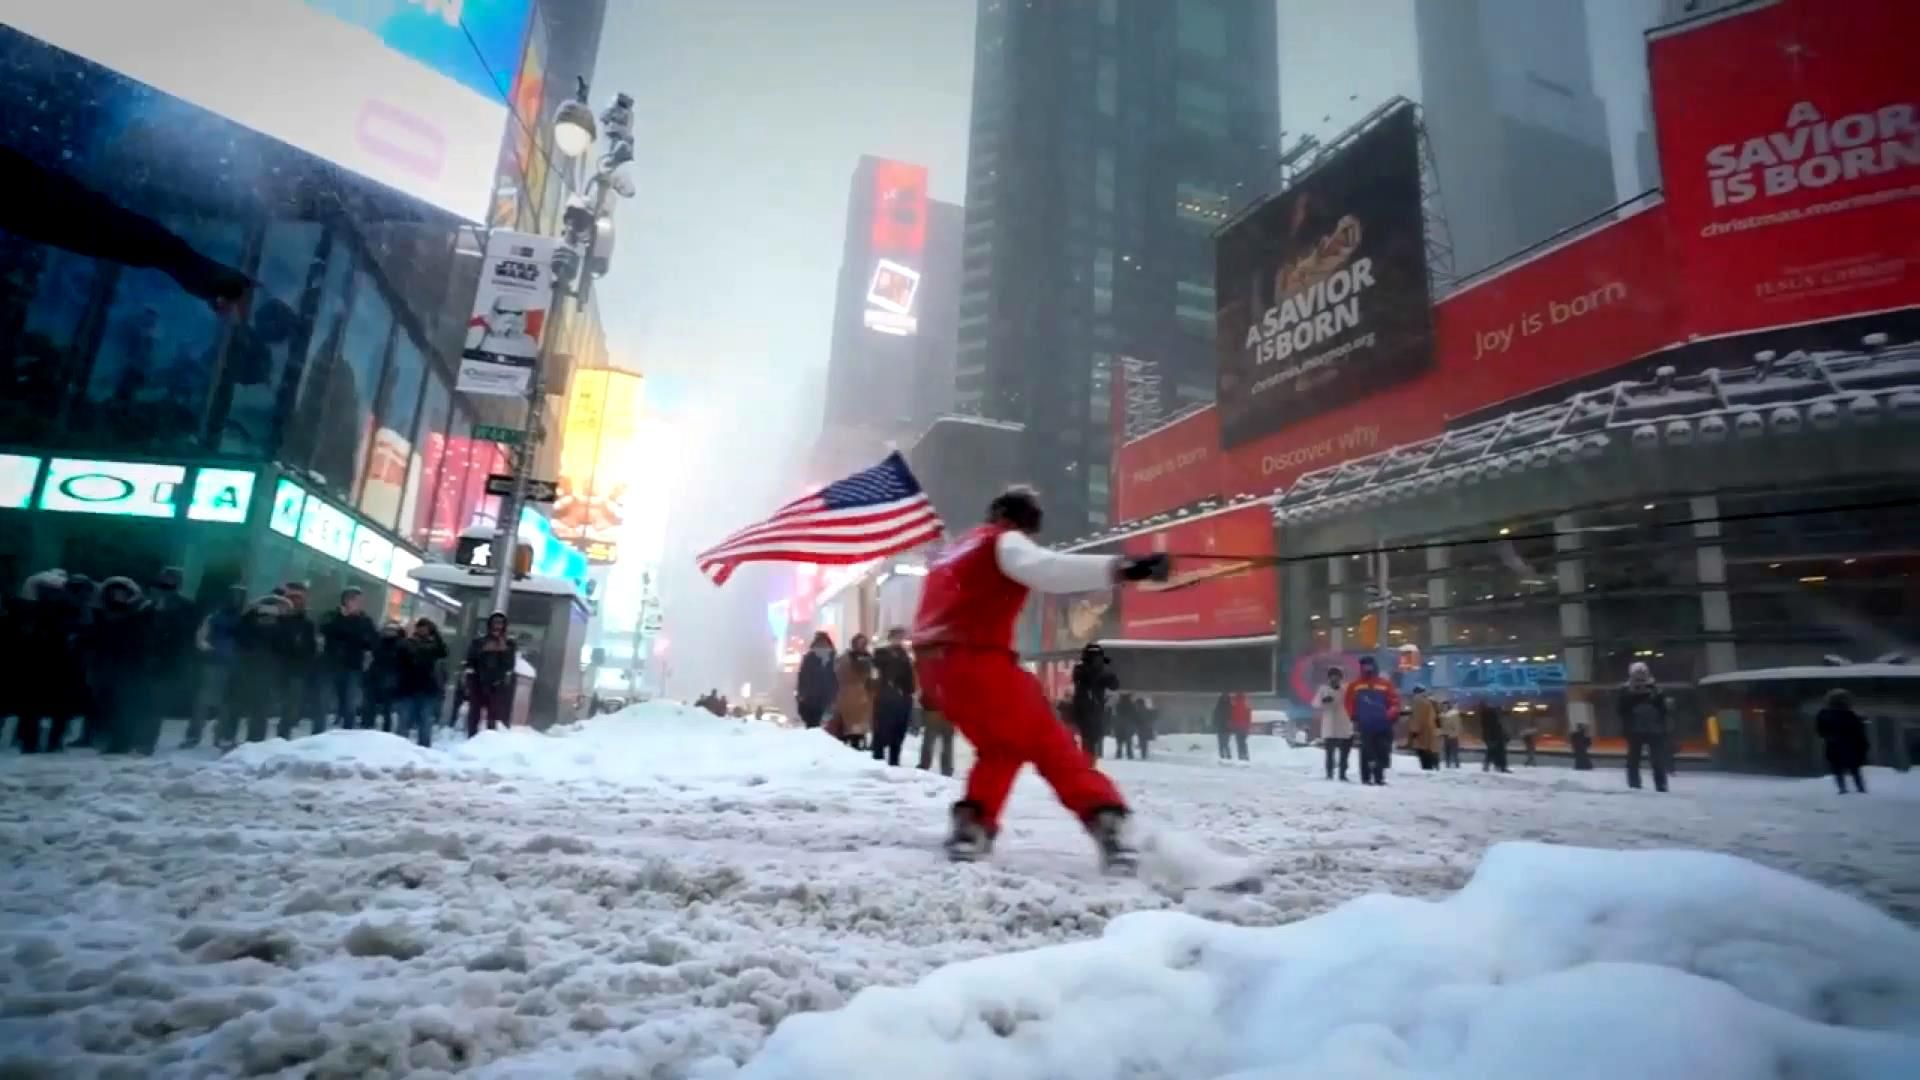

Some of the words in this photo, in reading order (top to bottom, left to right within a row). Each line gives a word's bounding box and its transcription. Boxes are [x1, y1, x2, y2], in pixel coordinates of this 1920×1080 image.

[1706, 104, 1917, 178] SAVIOR
[1787, 101, 1820, 128] A
[1710, 172, 1757, 208] IS
[1246, 324, 1262, 349] A
[1263, 257, 1376, 337] SAVIOR
[1256, 339, 1273, 365] IS
[1276, 297, 1359, 361] BORN
[1473, 323, 1515, 361] Joy
[1521, 312, 1544, 336] is
[1549, 281, 1627, 325] born
[1261, 438, 1333, 476] Discover
